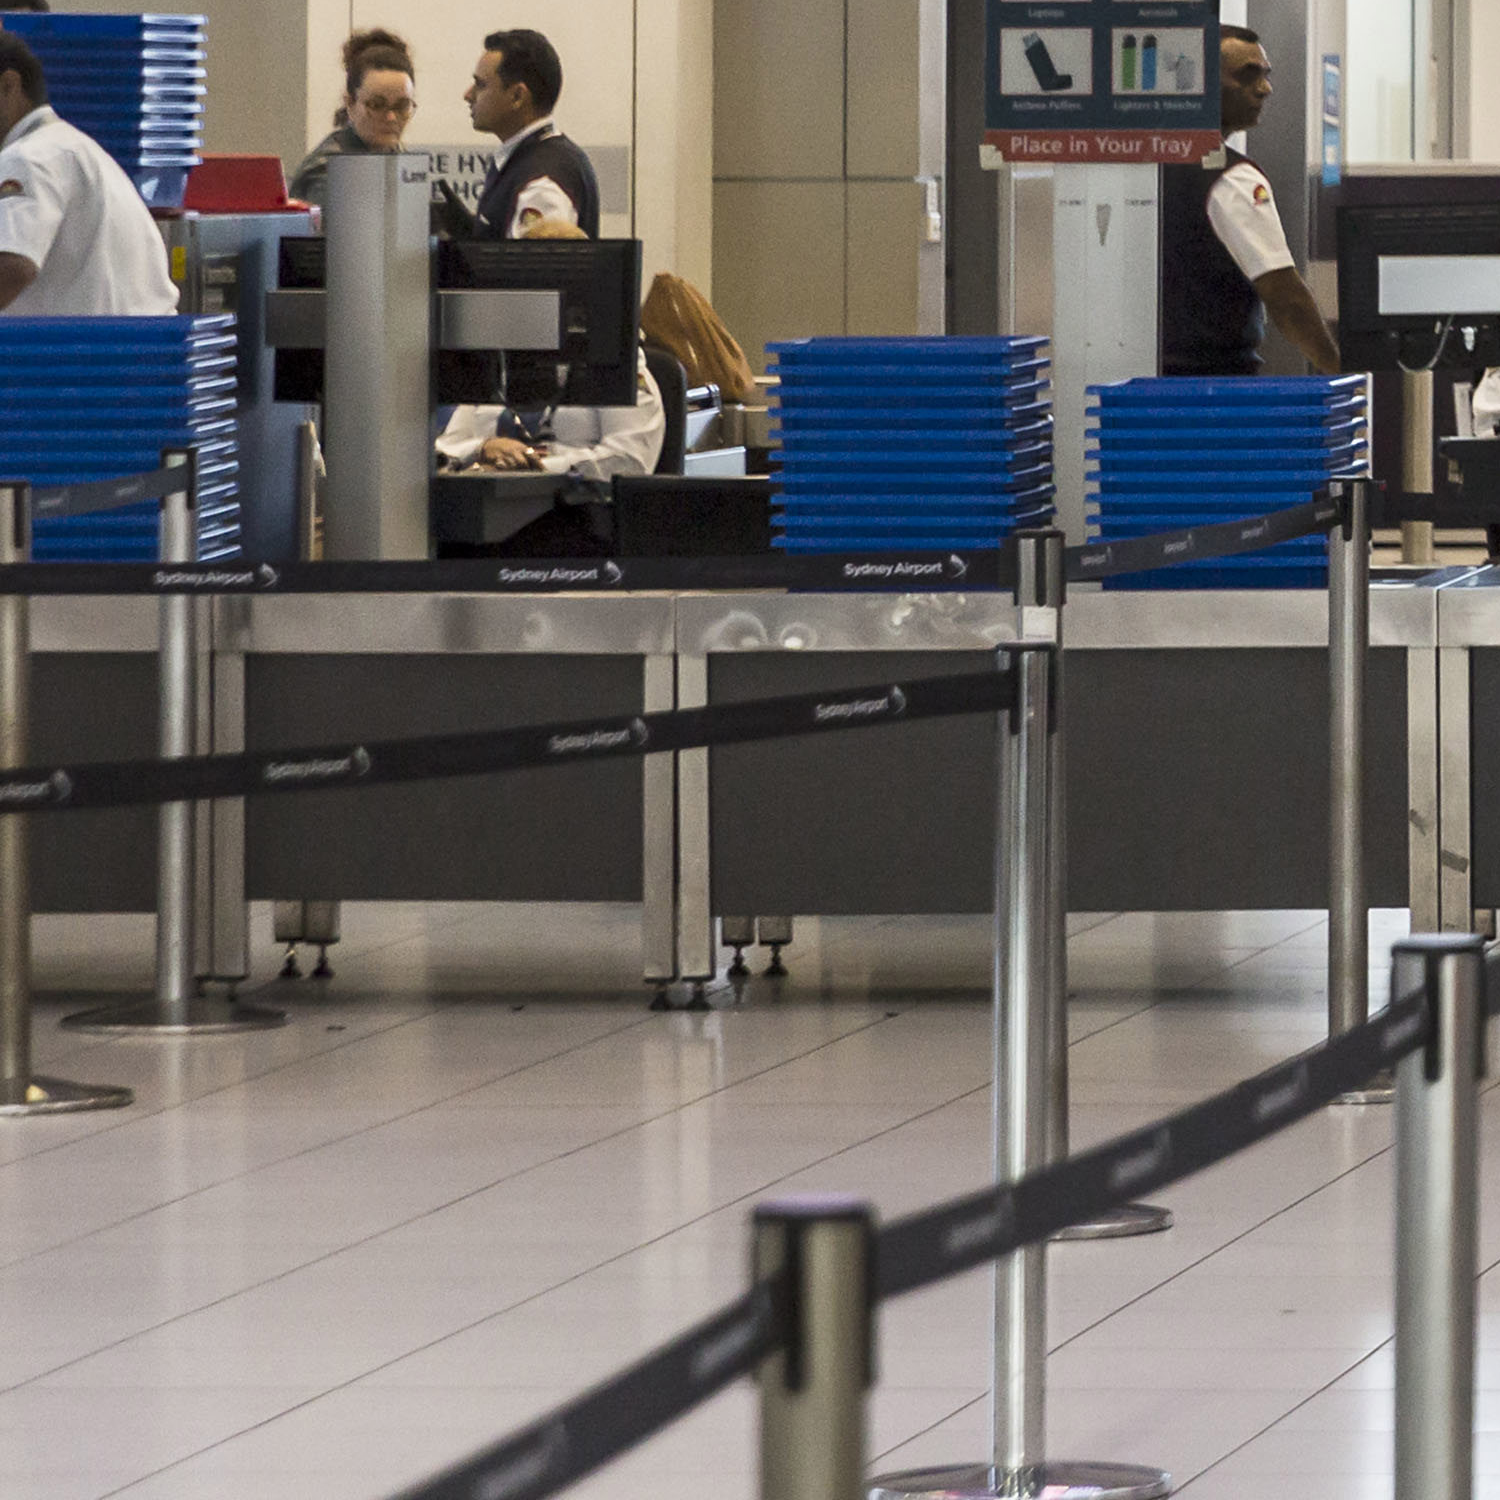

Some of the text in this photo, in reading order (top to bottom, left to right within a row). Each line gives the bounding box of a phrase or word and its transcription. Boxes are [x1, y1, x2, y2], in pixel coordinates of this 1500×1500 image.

[1011, 136, 1192, 157] Place in Your Tray
[499, 568, 597, 583] Sydney Airport
[844, 561, 943, 577] Sydney Airport
